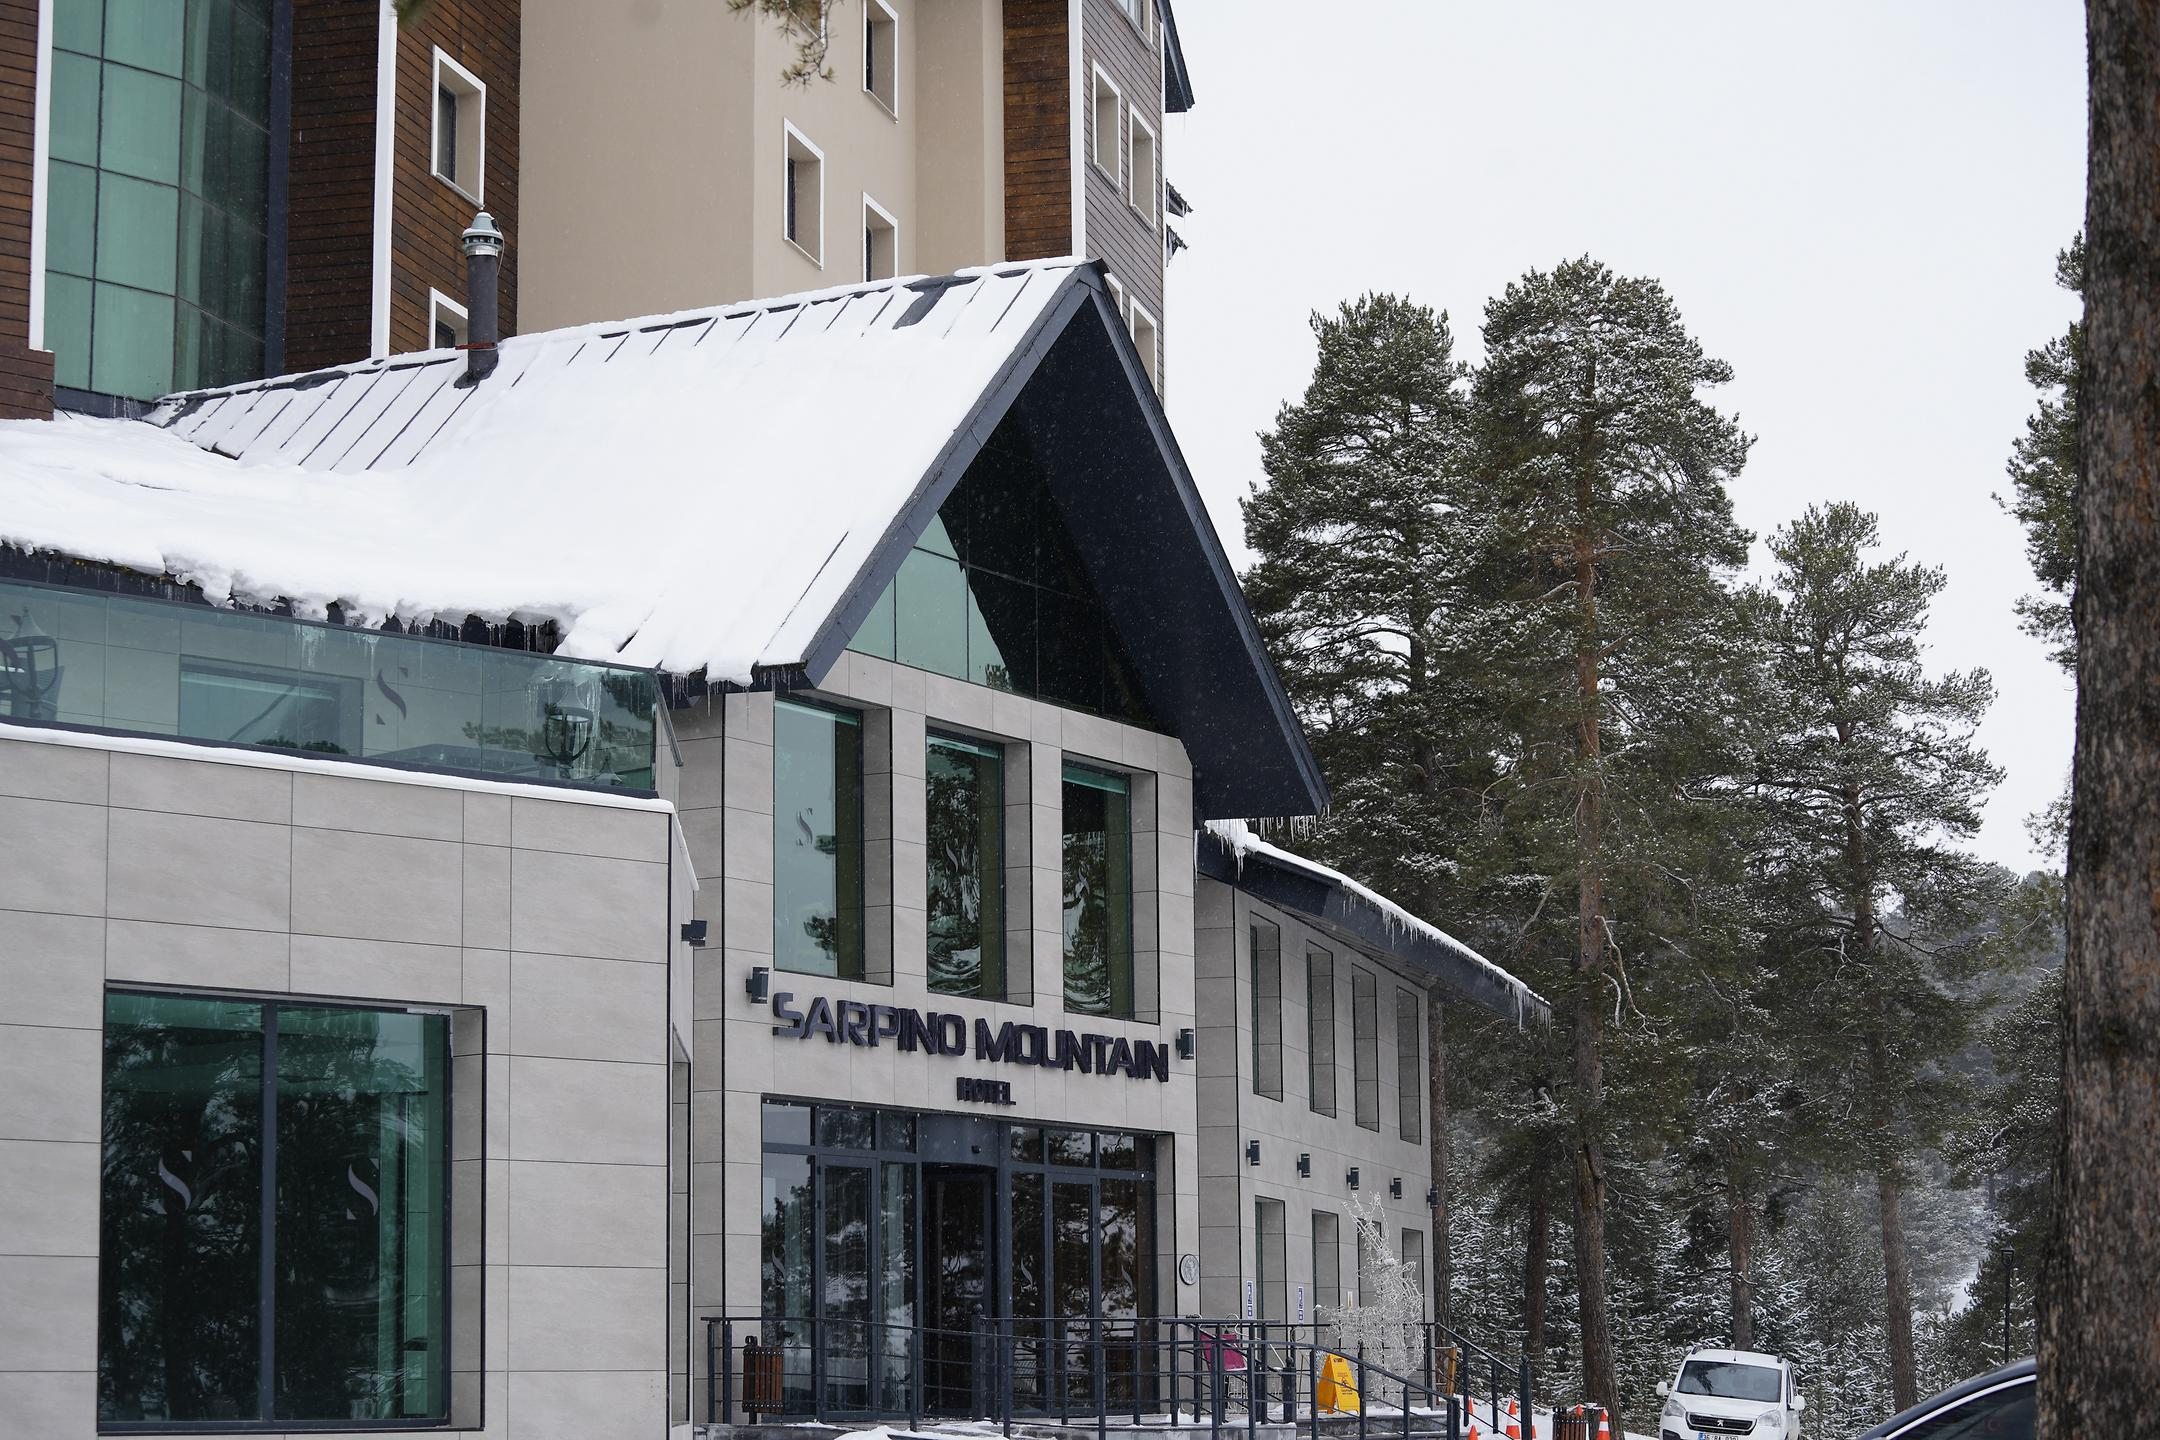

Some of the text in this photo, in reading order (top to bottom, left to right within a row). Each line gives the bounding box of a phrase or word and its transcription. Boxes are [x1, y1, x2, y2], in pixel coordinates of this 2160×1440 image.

[772, 992, 1169, 1083] SARPINO MOUNTAIN
[956, 1077, 1017, 1106] HOTEL
